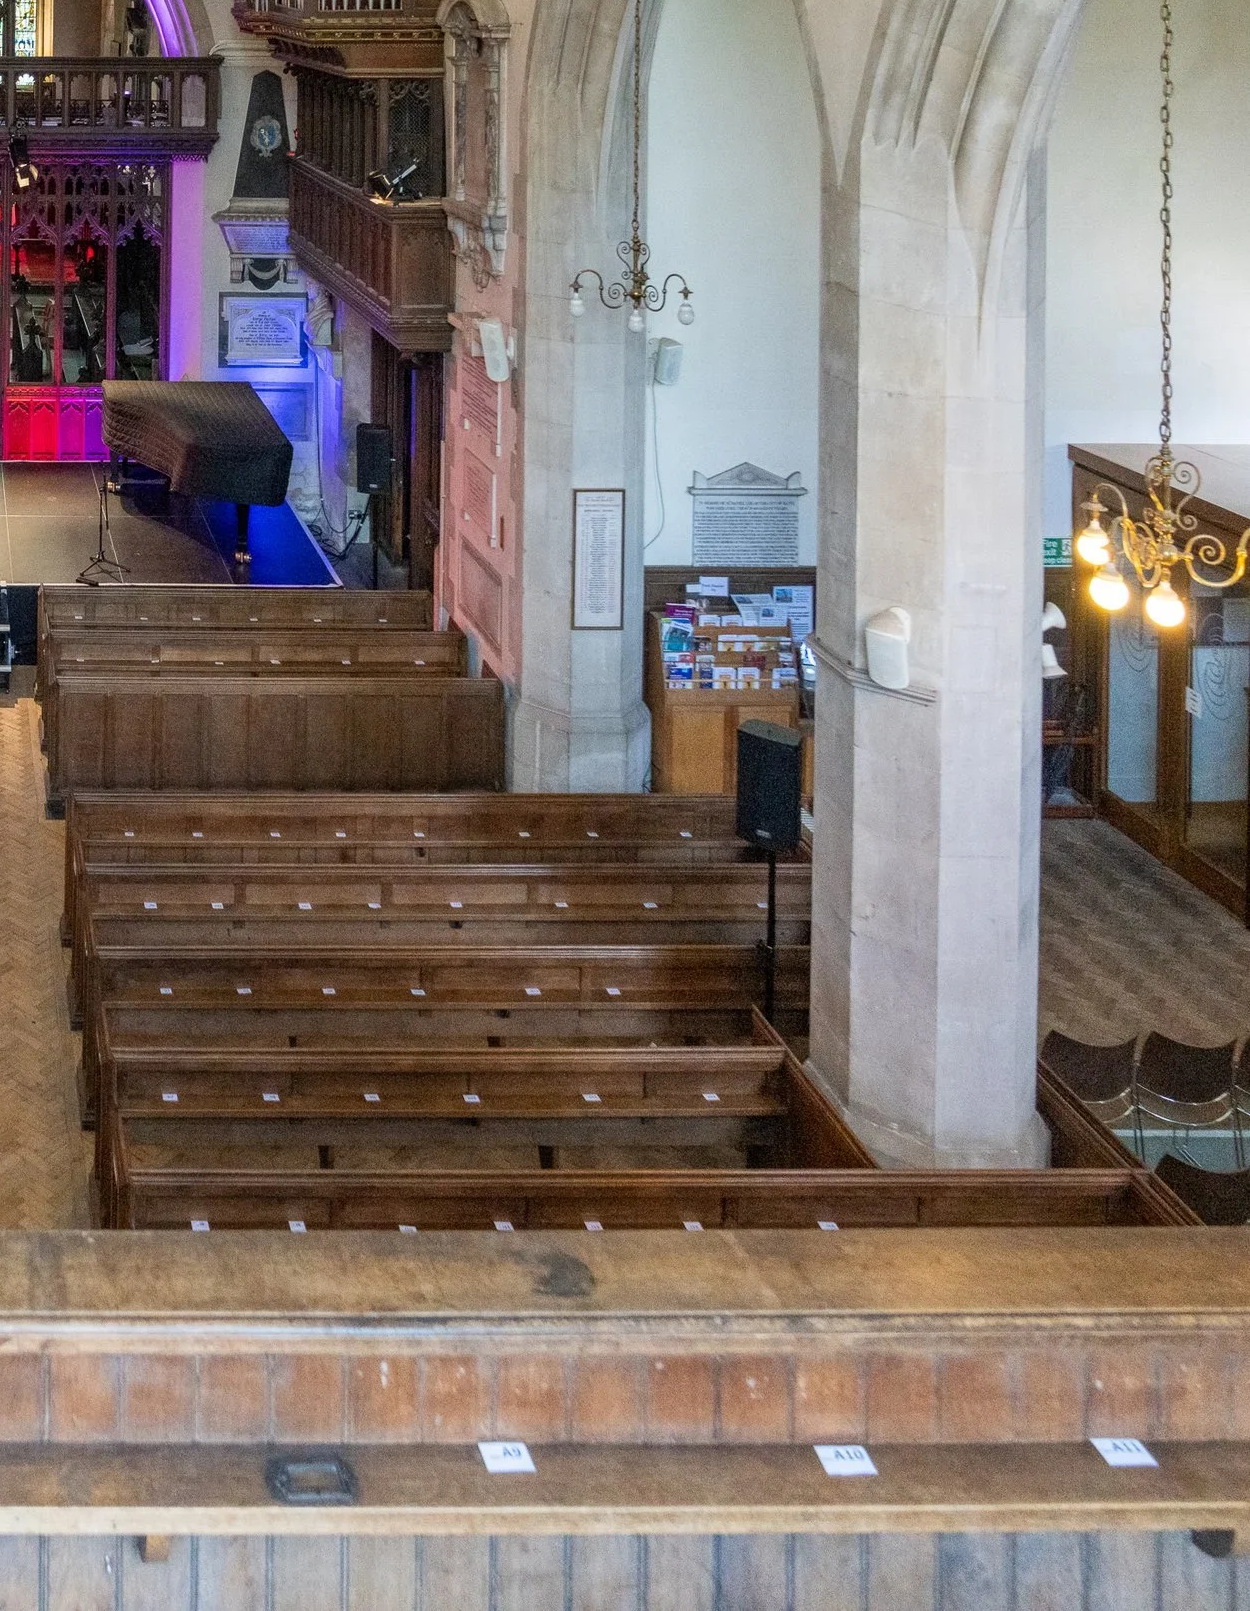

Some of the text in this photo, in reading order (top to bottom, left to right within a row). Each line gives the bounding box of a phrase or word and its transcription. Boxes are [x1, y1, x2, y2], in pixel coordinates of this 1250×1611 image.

[502, 1445, 522, 1457] A9
[1111, 1441, 1141, 1452] A11
[834, 1448, 864, 1460] A10
